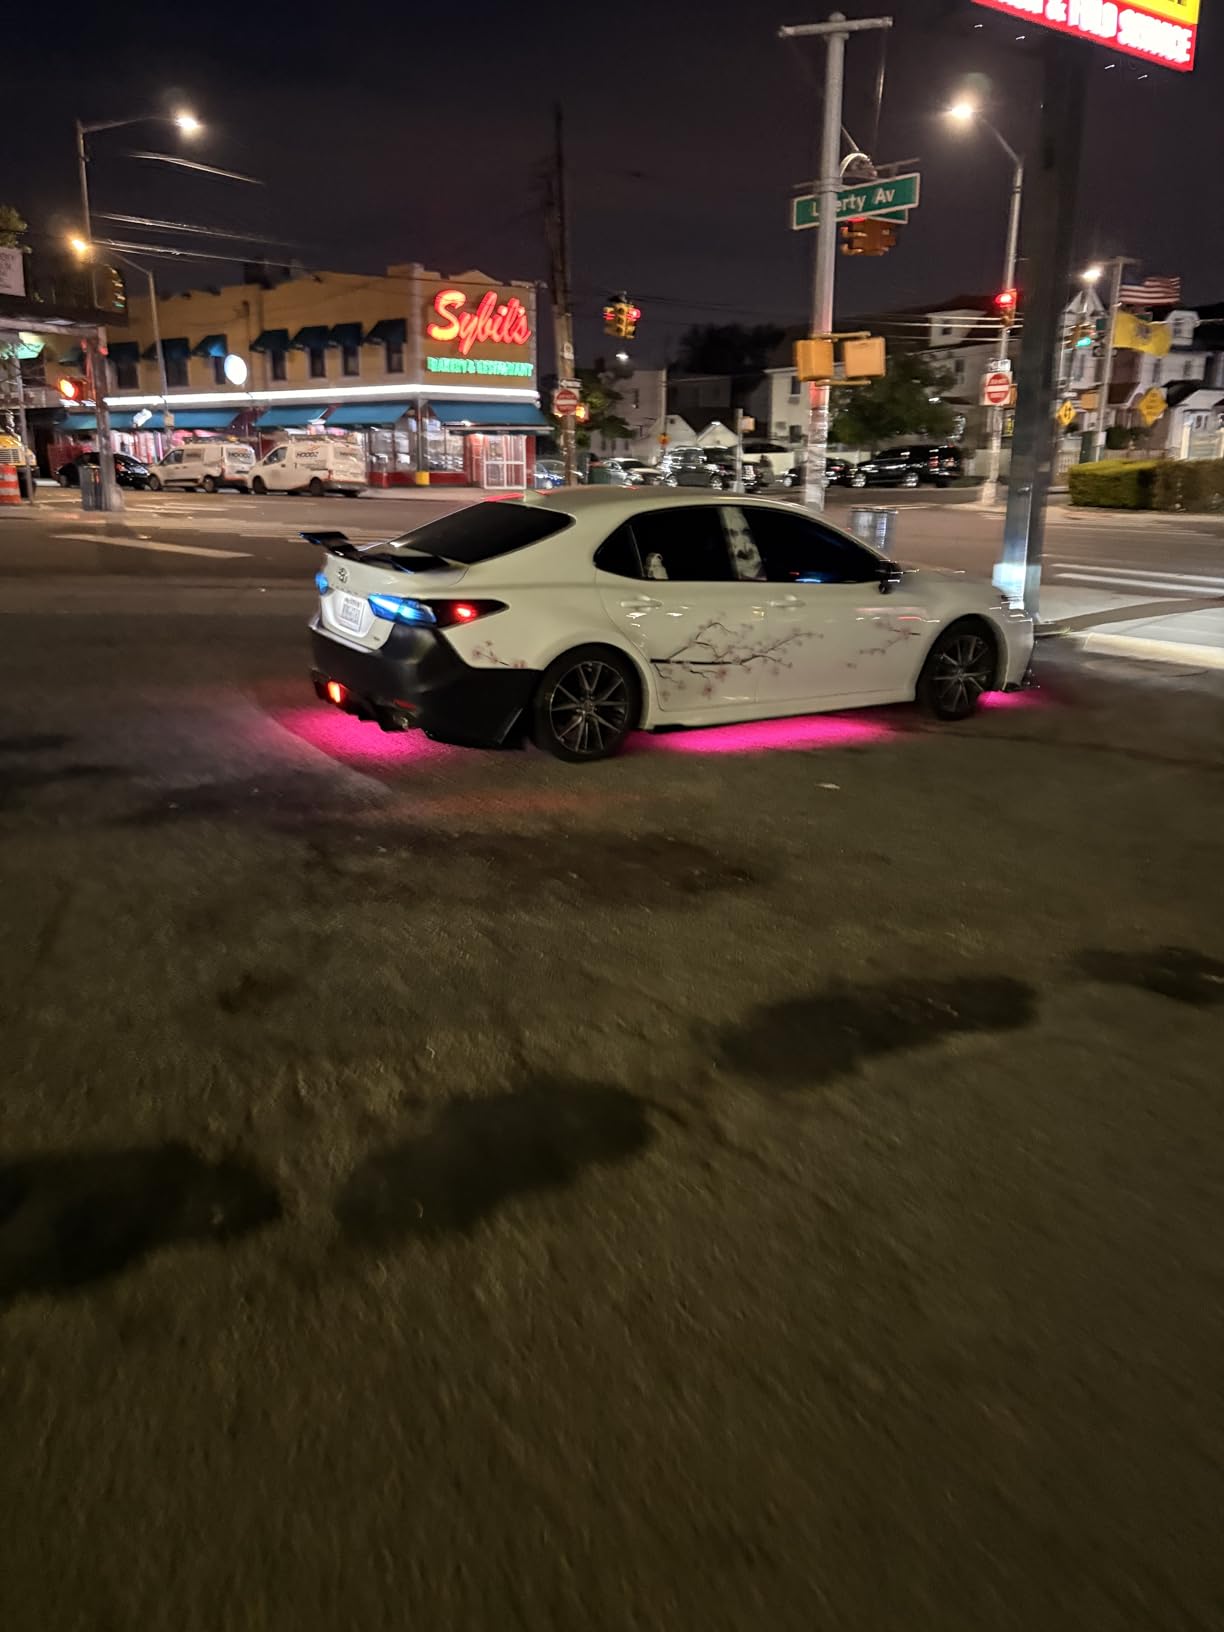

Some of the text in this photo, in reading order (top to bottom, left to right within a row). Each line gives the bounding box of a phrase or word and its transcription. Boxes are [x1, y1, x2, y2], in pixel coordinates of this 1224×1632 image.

[811, 187, 896, 217] Lerty Av
[427, 289, 532, 355] Sybil's
